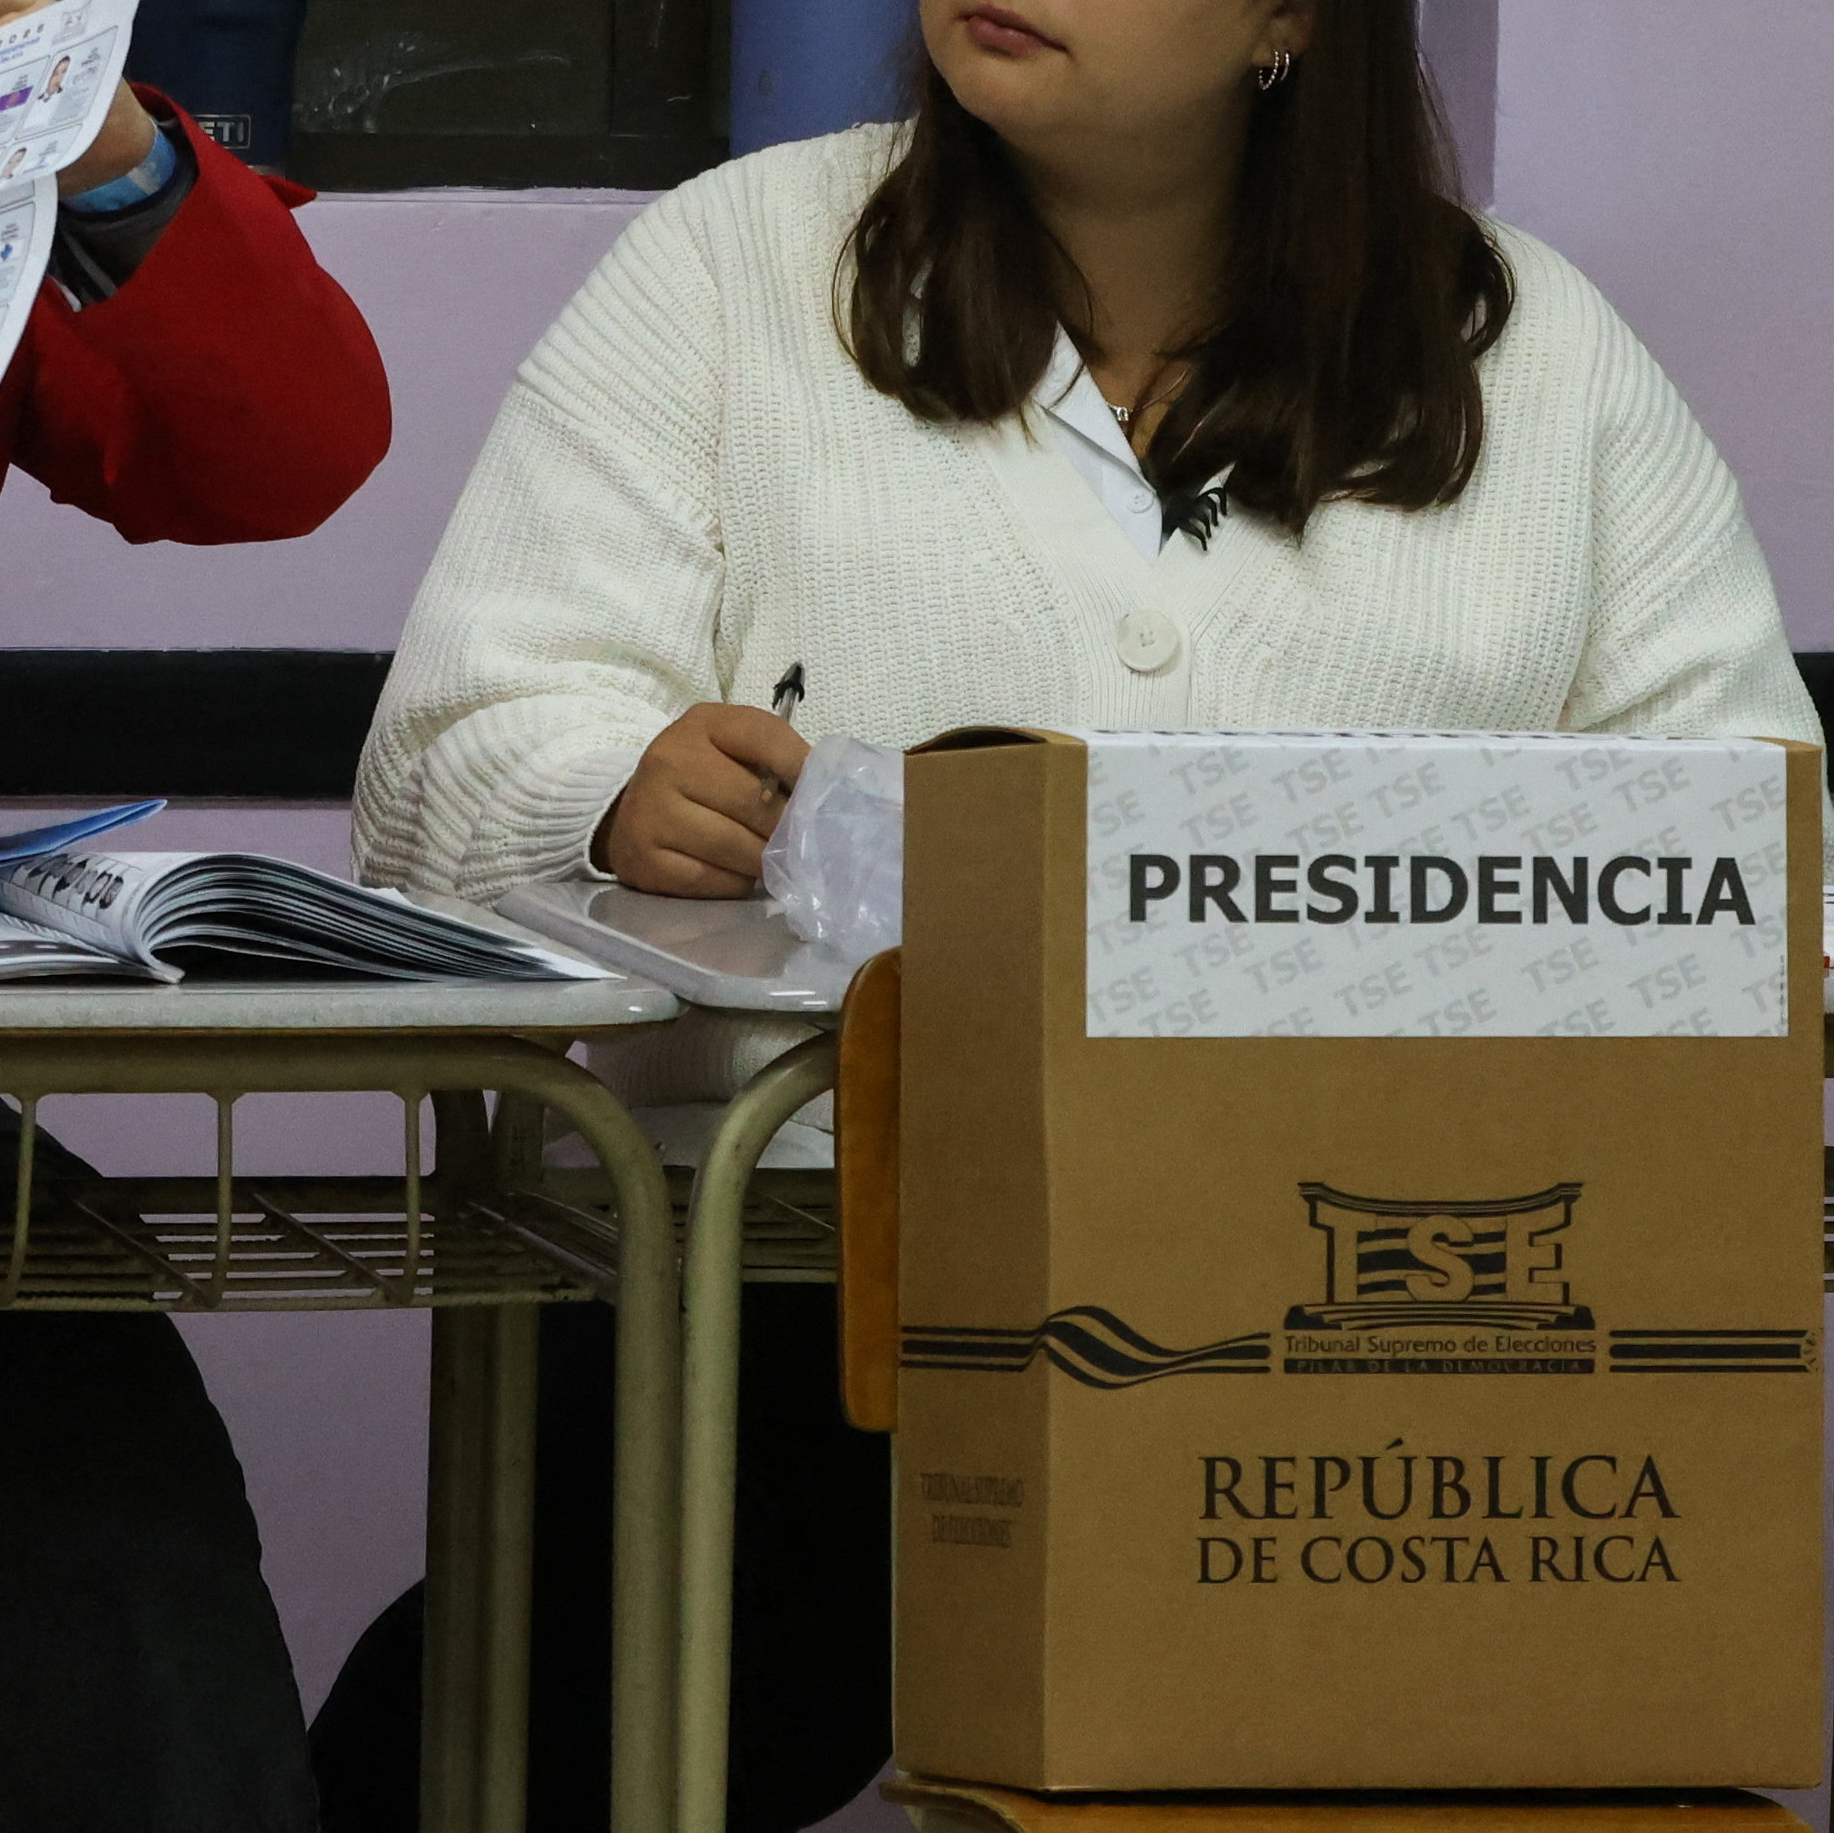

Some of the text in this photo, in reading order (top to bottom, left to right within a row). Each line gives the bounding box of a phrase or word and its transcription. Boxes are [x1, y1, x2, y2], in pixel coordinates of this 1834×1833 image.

[197, 121, 246, 143] ETI
[1271, 748, 1354, 804] TSE
[1367, 760, 1447, 819] TSE
[1611, 756, 1692, 813] TSE
[1710, 774, 1786, 833] TSE
[1089, 789, 1147, 838] SE
[1178, 792, 1261, 848] TSE
[1285, 801, 1366, 857] TSE
[1450, 784, 1531, 842] TSE
[1520, 802, 1600, 856] TSE
[1129, 854, 1757, 926] PRESIDENCIA
[1173, 924, 1255, 977] TSE
[1242, 937, 1325, 995] TSE
[1412, 925, 1494, 978] TSE
[1520, 936, 1600, 994] TSE
[1332, 961, 1414, 1018] TSE
[1626, 952, 1708, 1010] TSE
[1307, 1198, 1572, 1304] TSE
[1285, 1335, 1597, 1358] Tribunal Supremo de Elecciones
[1197, 1437, 1683, 1521] REPÚBLICA
[1195, 1534, 1683, 1585] DE COSTA RICA
